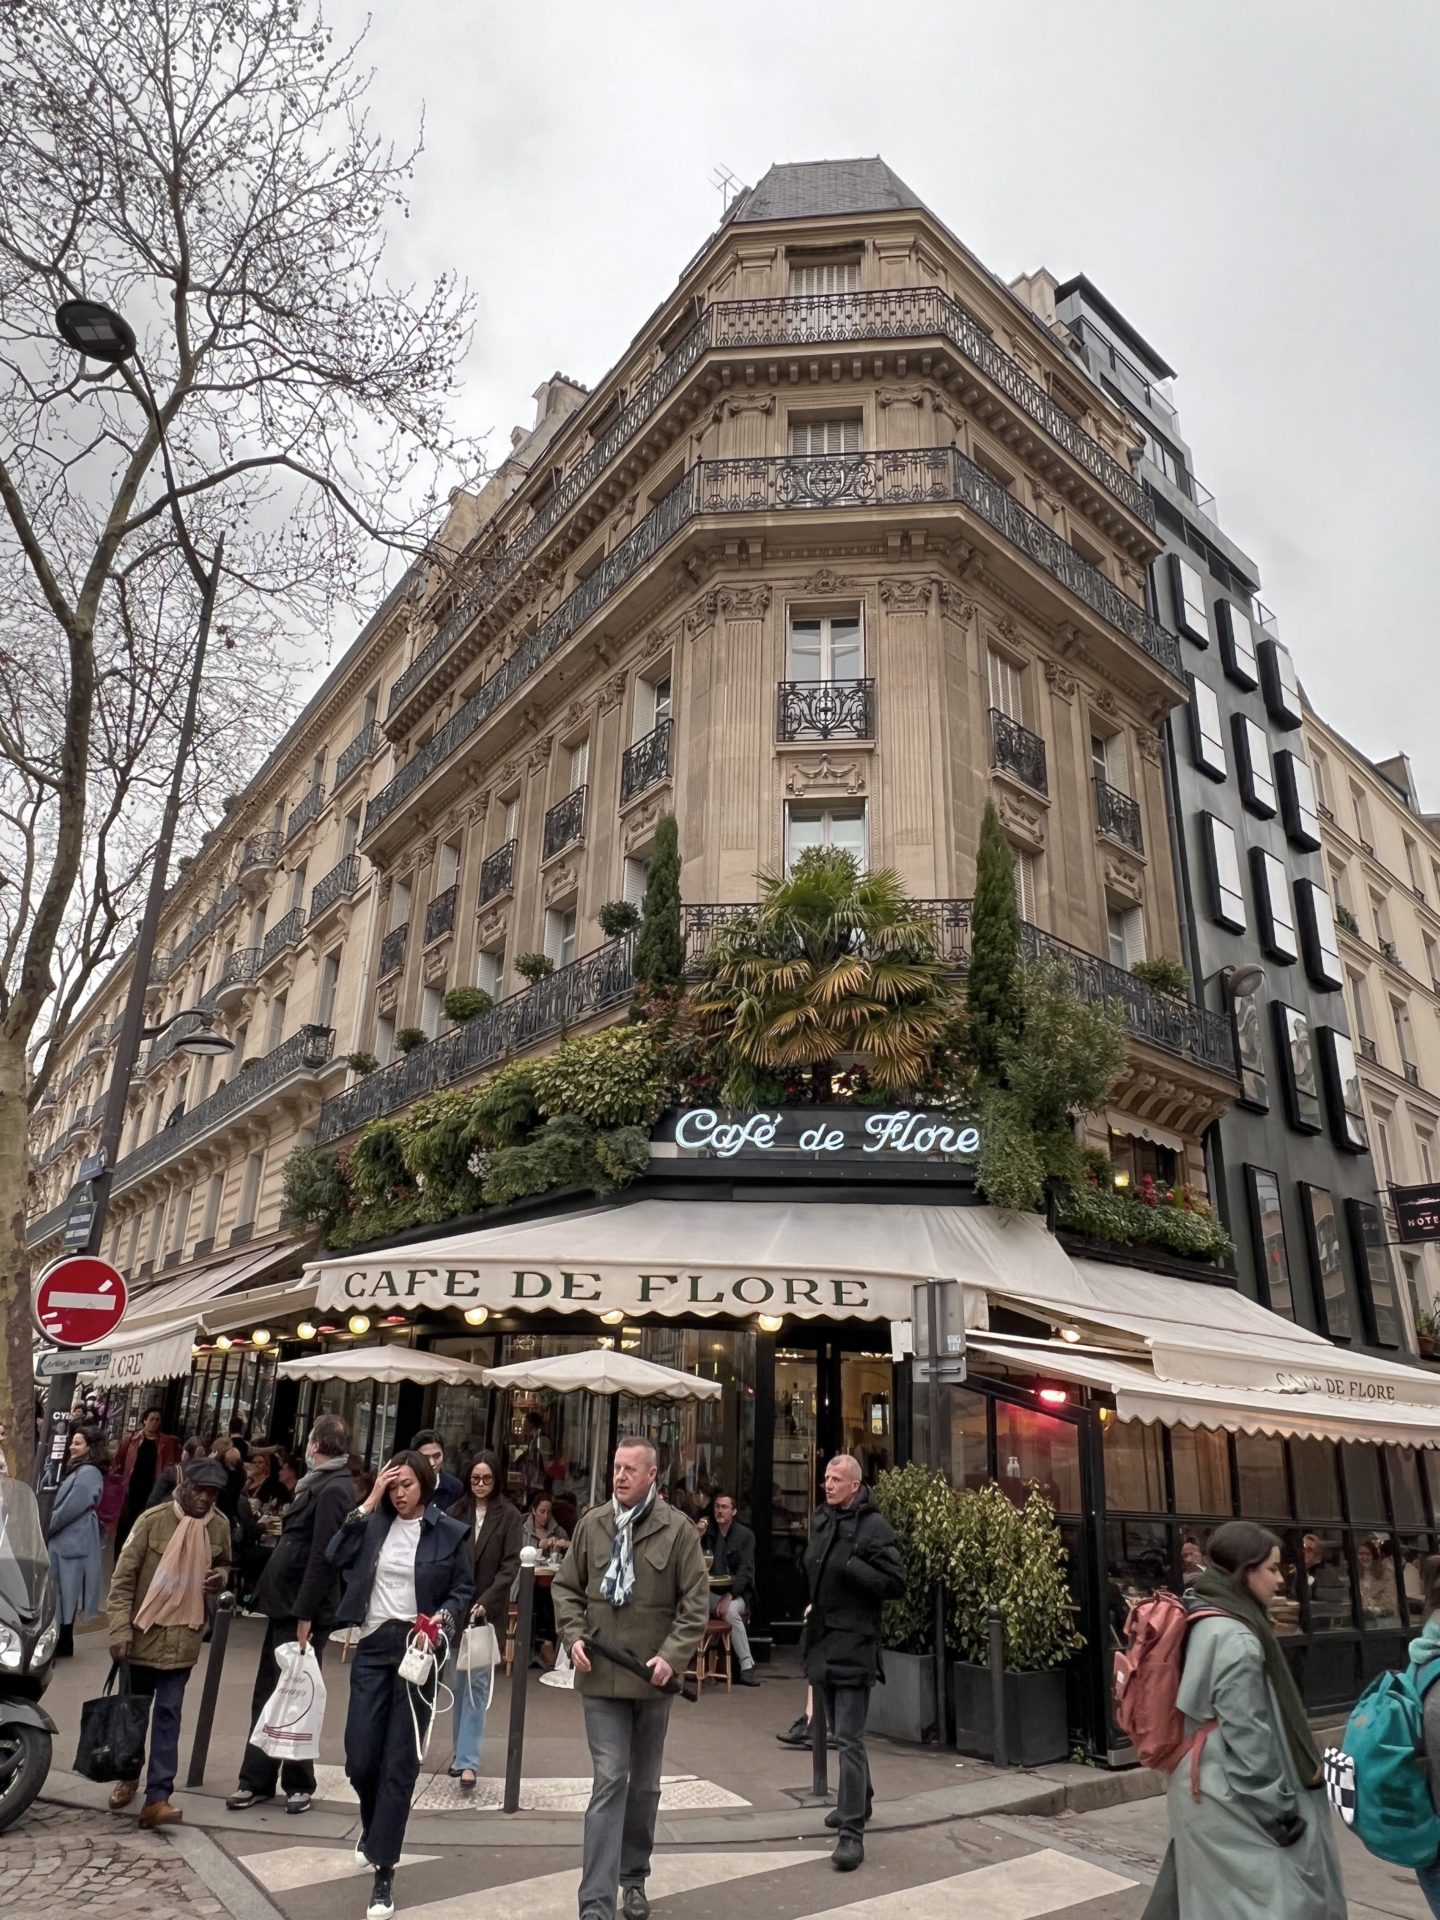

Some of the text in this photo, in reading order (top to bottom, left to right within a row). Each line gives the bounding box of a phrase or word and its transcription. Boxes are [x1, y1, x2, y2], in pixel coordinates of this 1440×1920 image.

[675, 1108, 979, 1158] Café de Flore
[344, 1269, 869, 1307] CAFE DE FLORE
[103, 1352, 143, 1379] LORE
[1325, 1378, 1344, 1394] DE
[1349, 1381, 1395, 1400] FLORE
